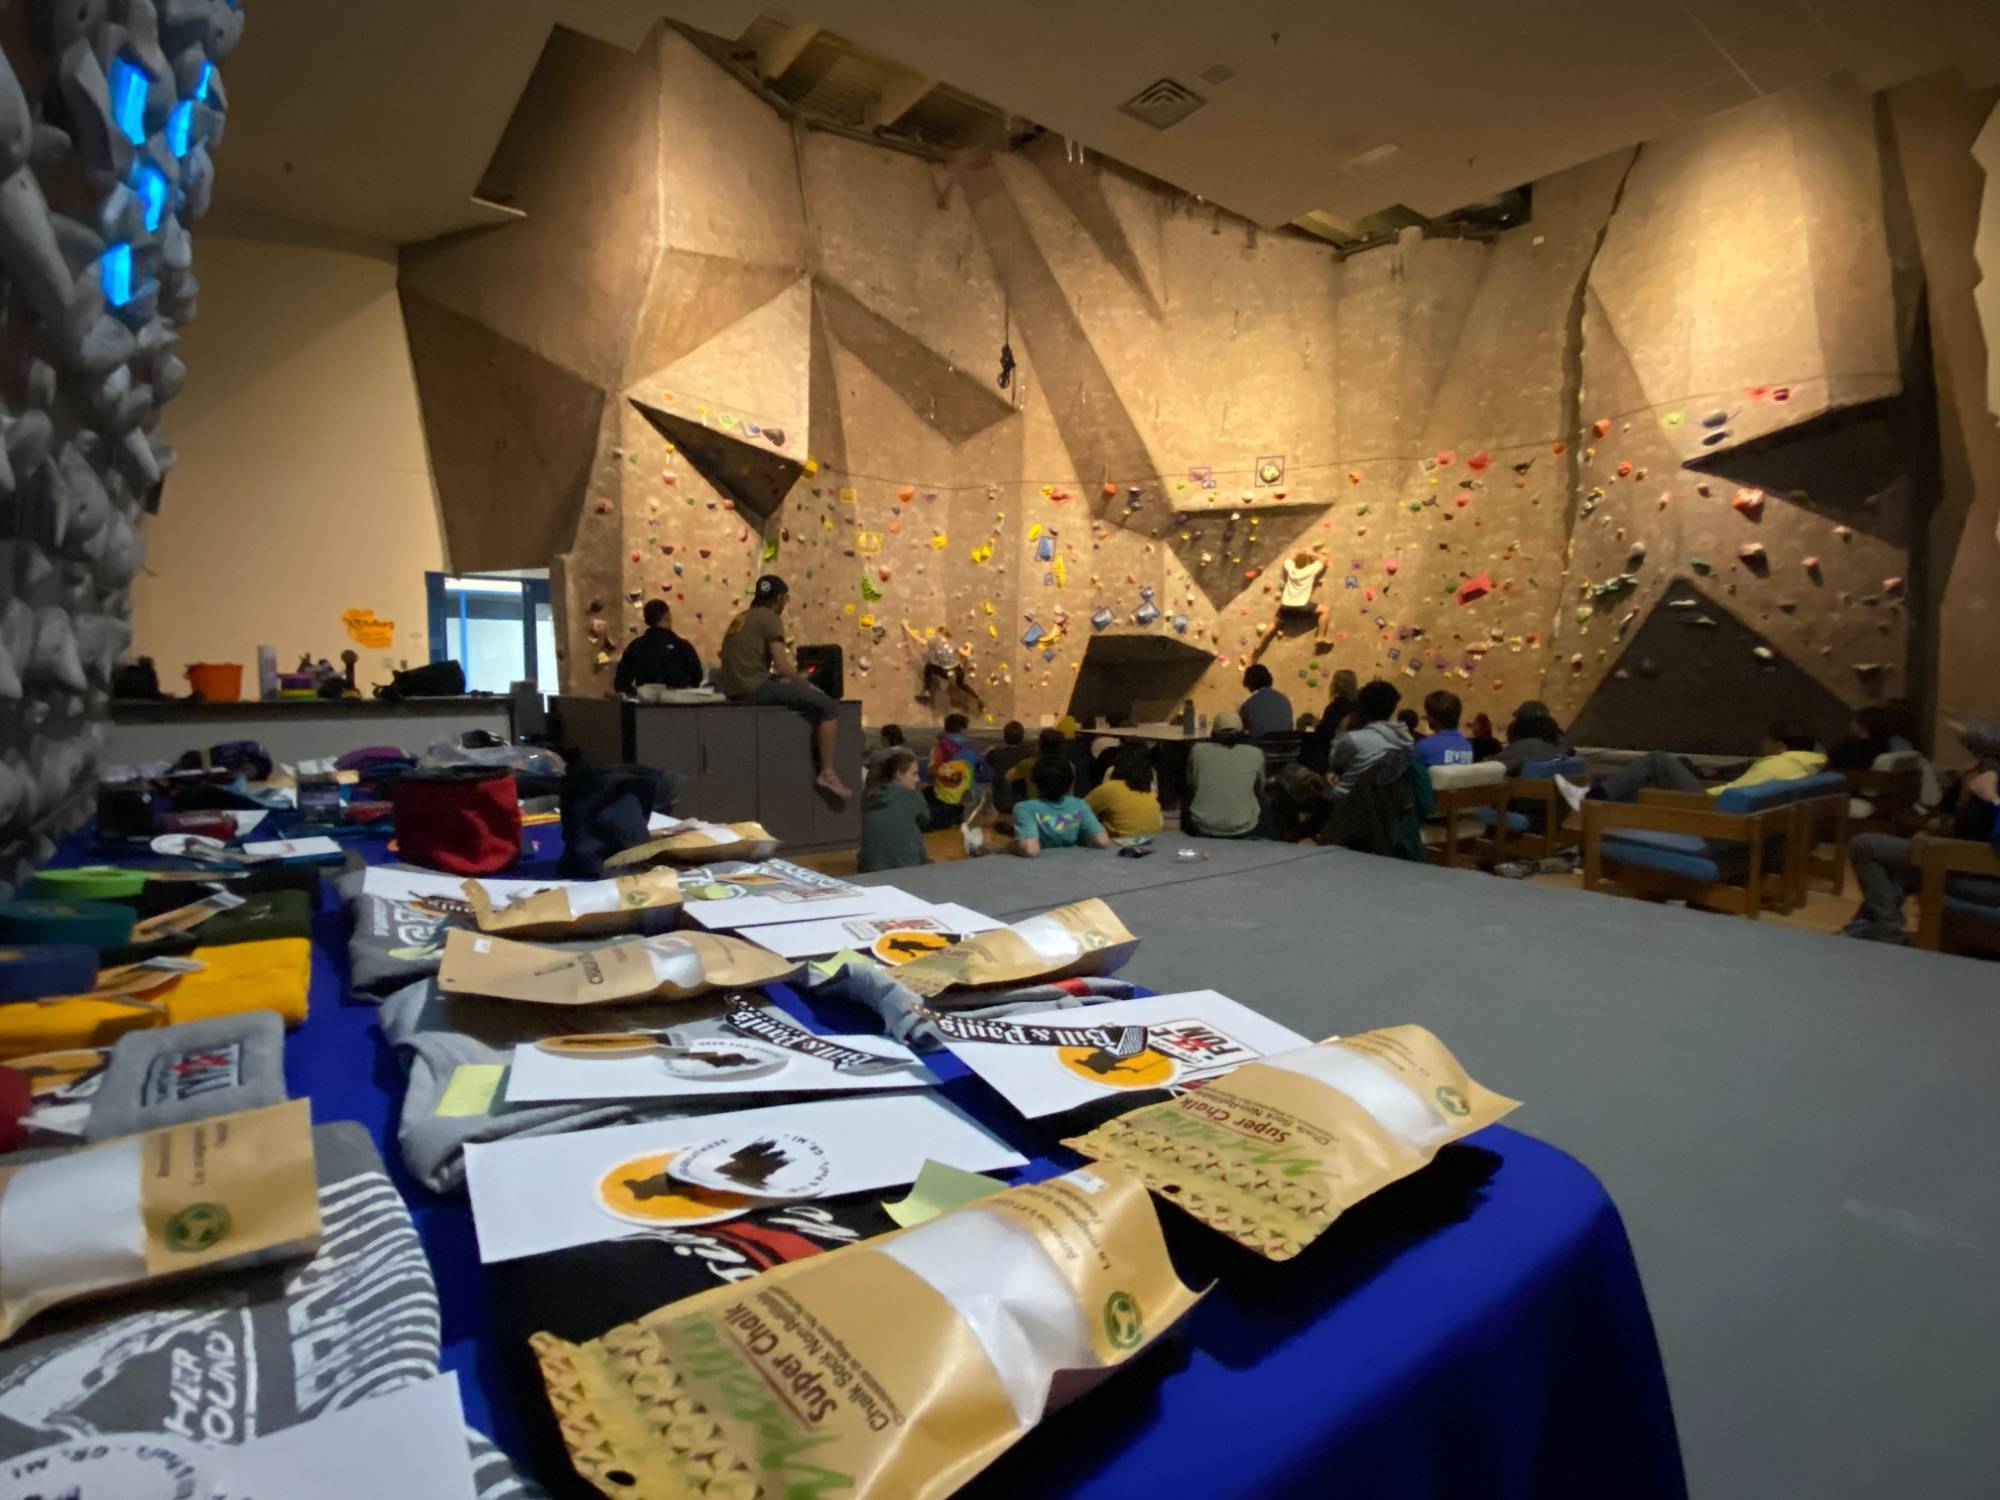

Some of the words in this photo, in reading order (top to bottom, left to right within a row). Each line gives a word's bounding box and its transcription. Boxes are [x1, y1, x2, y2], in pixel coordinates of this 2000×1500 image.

[938, 1017, 1032, 1044] Paul's
[1031, 1027, 1051, 1041] &
[1055, 1028, 1115, 1047] Bill
[1179, 1097, 1231, 1122] Chalk
[1233, 1116, 1292, 1144] Super
[724, 1301, 779, 1354] Chalk
[817, 1349, 853, 1390] Sock
[774, 1353, 839, 1424] Super
[847, 1381, 890, 1433] Chalk
